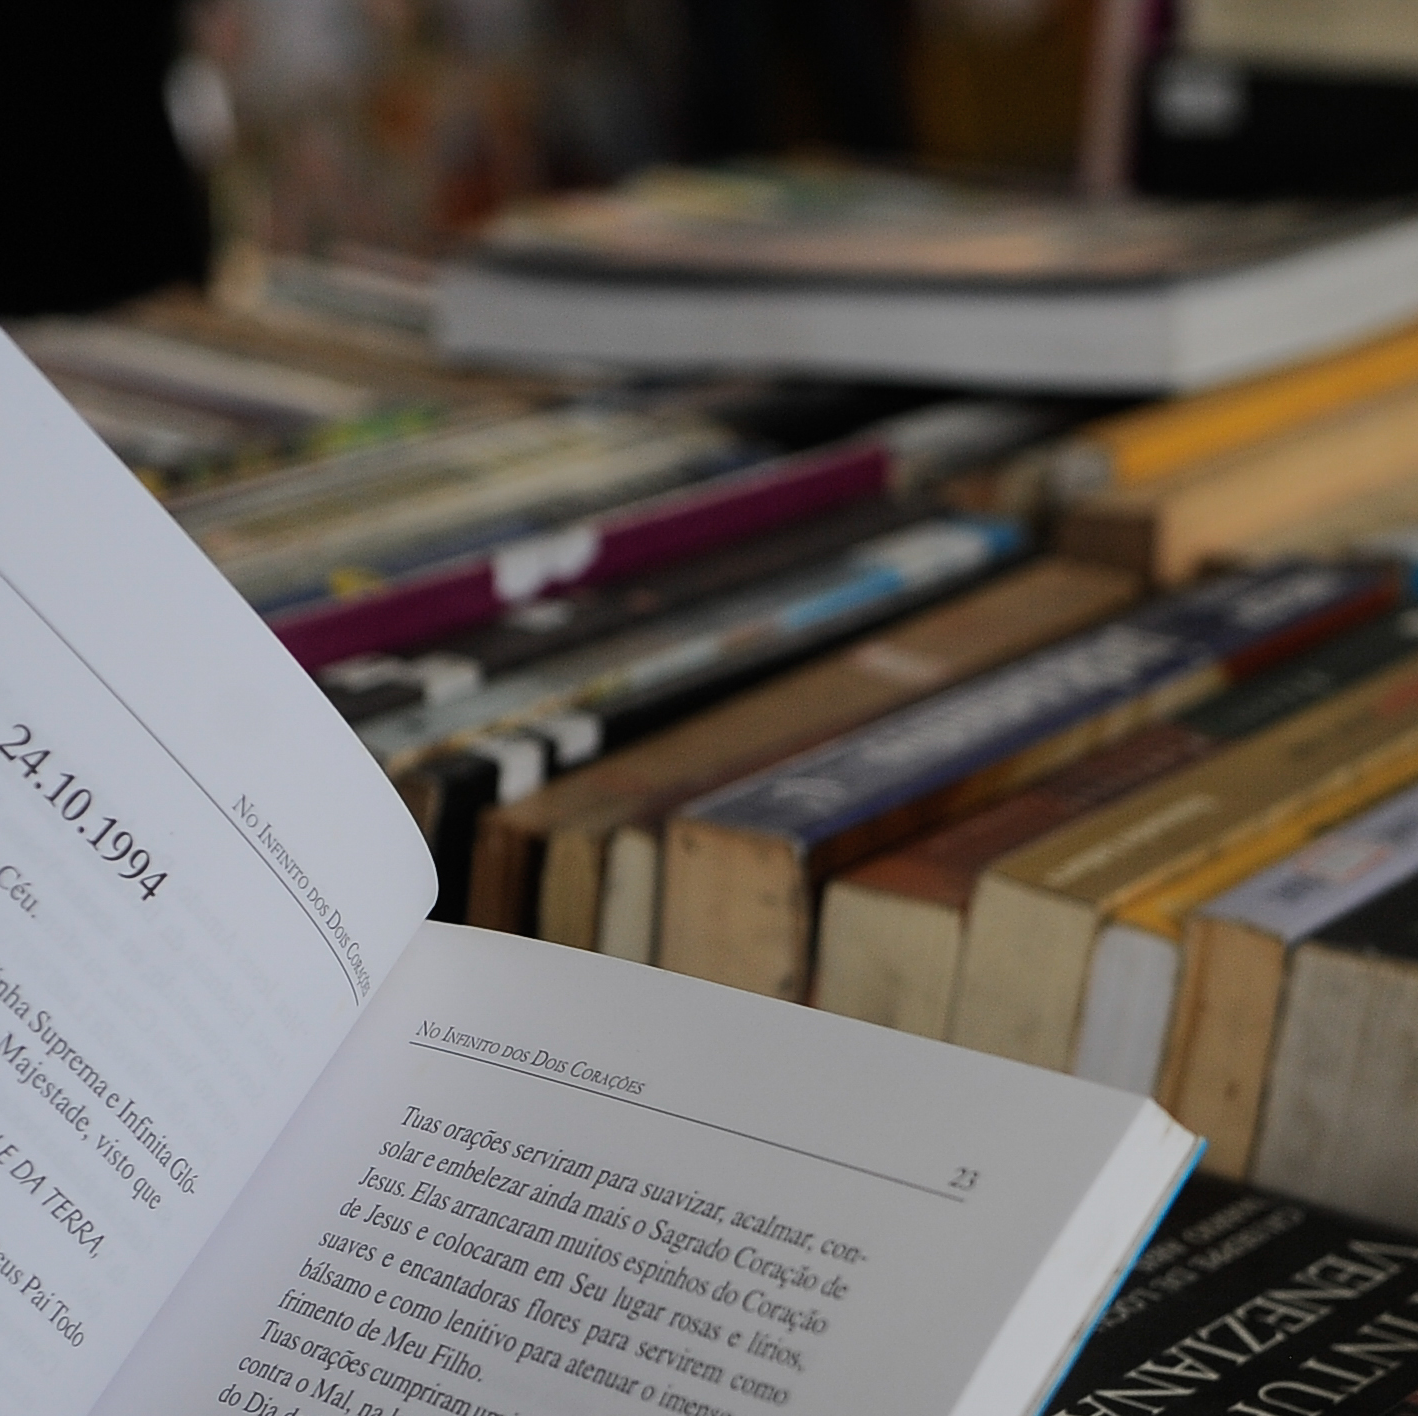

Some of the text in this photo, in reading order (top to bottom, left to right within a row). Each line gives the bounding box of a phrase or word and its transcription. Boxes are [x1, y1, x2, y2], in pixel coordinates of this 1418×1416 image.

[414, 1019, 441, 1039] NO
[440, 1025, 501, 1054] INFINITO
[499, 1044, 531, 1063] DOS
[528, 1048, 569, 1073] DOIS
[26, 1009, 108, 1098] Suprema
[104, 1092, 120, 1109] e
[114, 1097, 173, 1168] Infinita
[168, 1157, 199, 1194] Gló-
[8, 1158, 47, 1195] DA
[40, 1186, 105, 1259] TERRA,
[400, 1105, 866, 1263] Tuas orações serviram para suavizar, acalmar, con-
[276, 1287, 482, 1382] frimento de Meu Filho.
